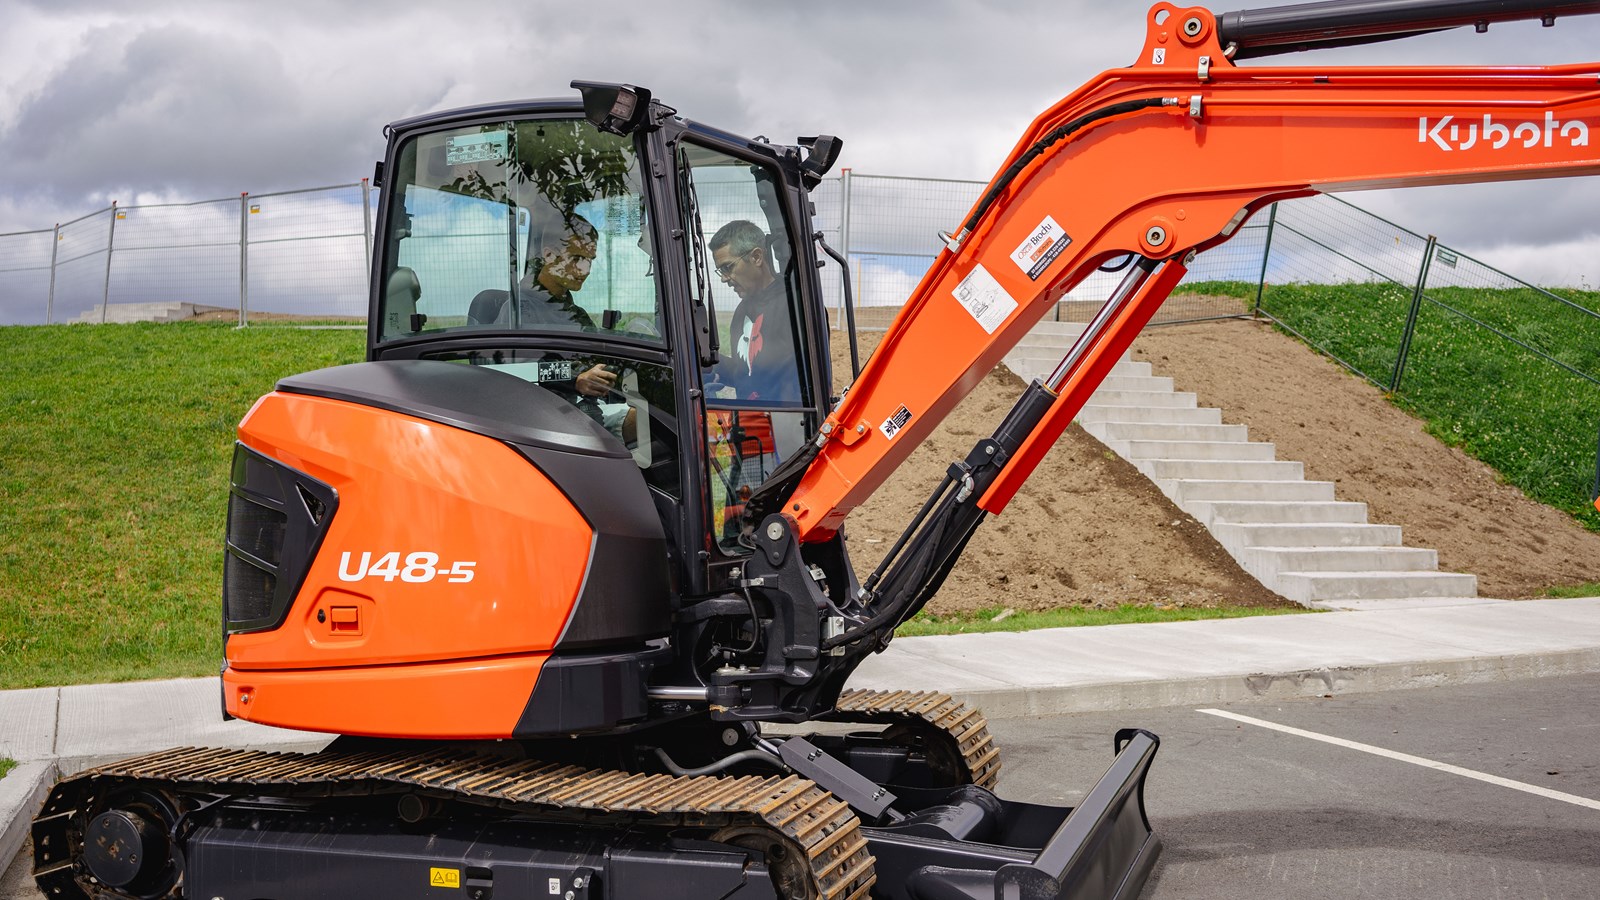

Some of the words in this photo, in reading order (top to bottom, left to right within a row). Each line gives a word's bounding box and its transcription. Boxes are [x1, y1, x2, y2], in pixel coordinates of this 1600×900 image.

[1418, 111, 1589, 151] Kubota
[1030, 222, 1052, 246] Brochu
[338, 551, 477, 583] U48-5
